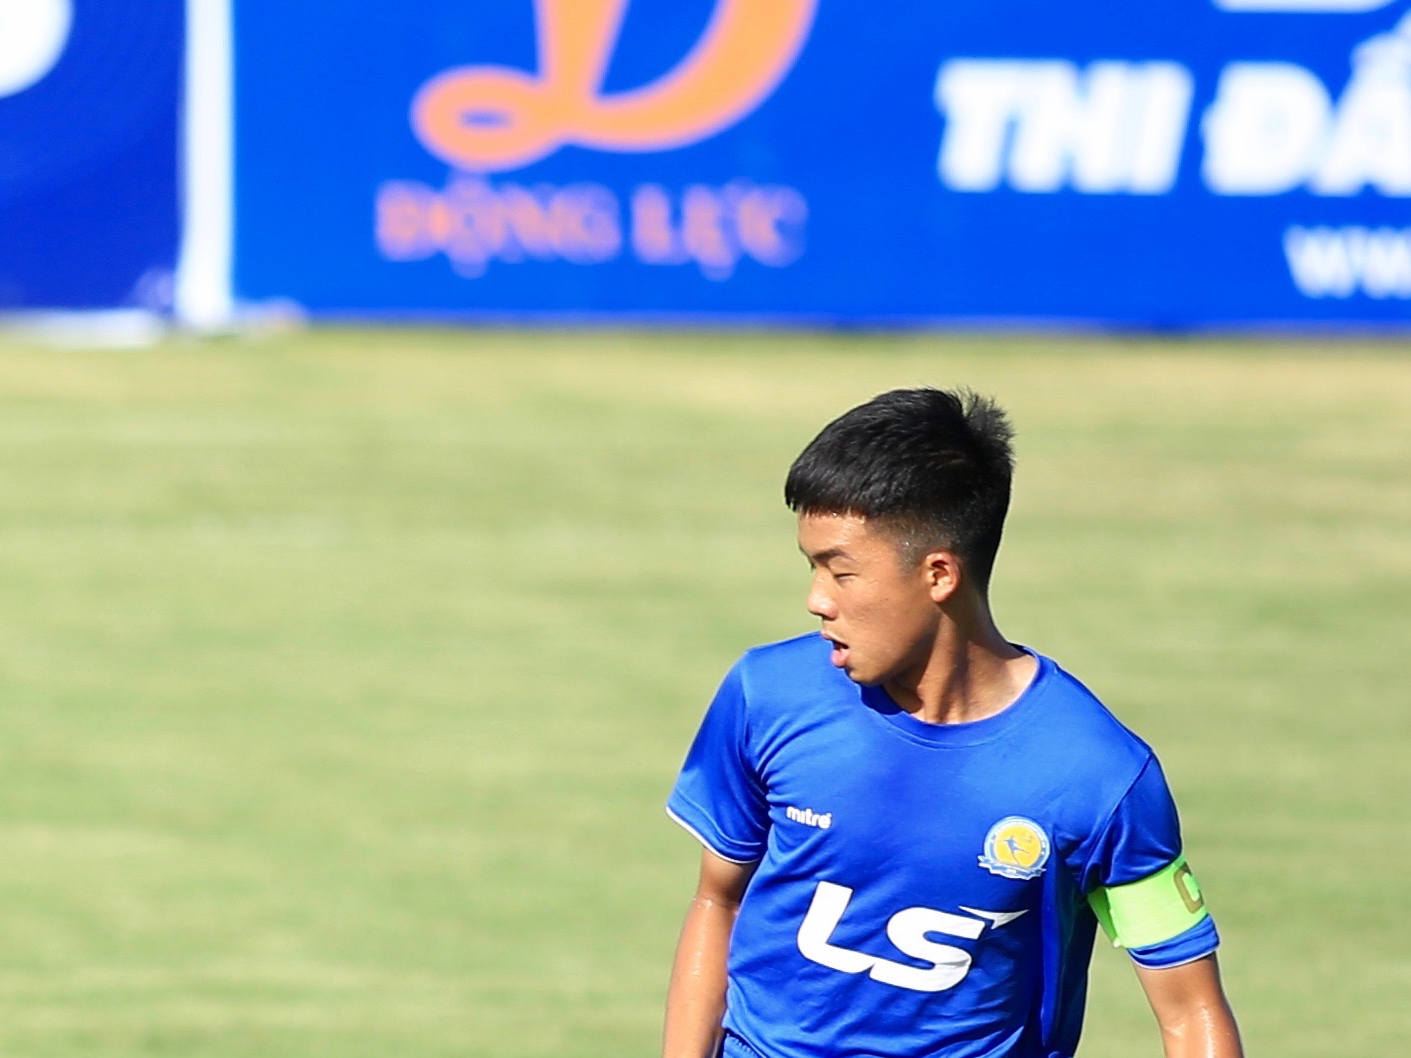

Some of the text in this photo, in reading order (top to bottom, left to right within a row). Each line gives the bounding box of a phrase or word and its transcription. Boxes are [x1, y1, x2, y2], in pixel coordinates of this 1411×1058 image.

[934, 56, 1195, 196] THI
[786, 805, 832, 829] mitre
[796, 879, 986, 993] LS
